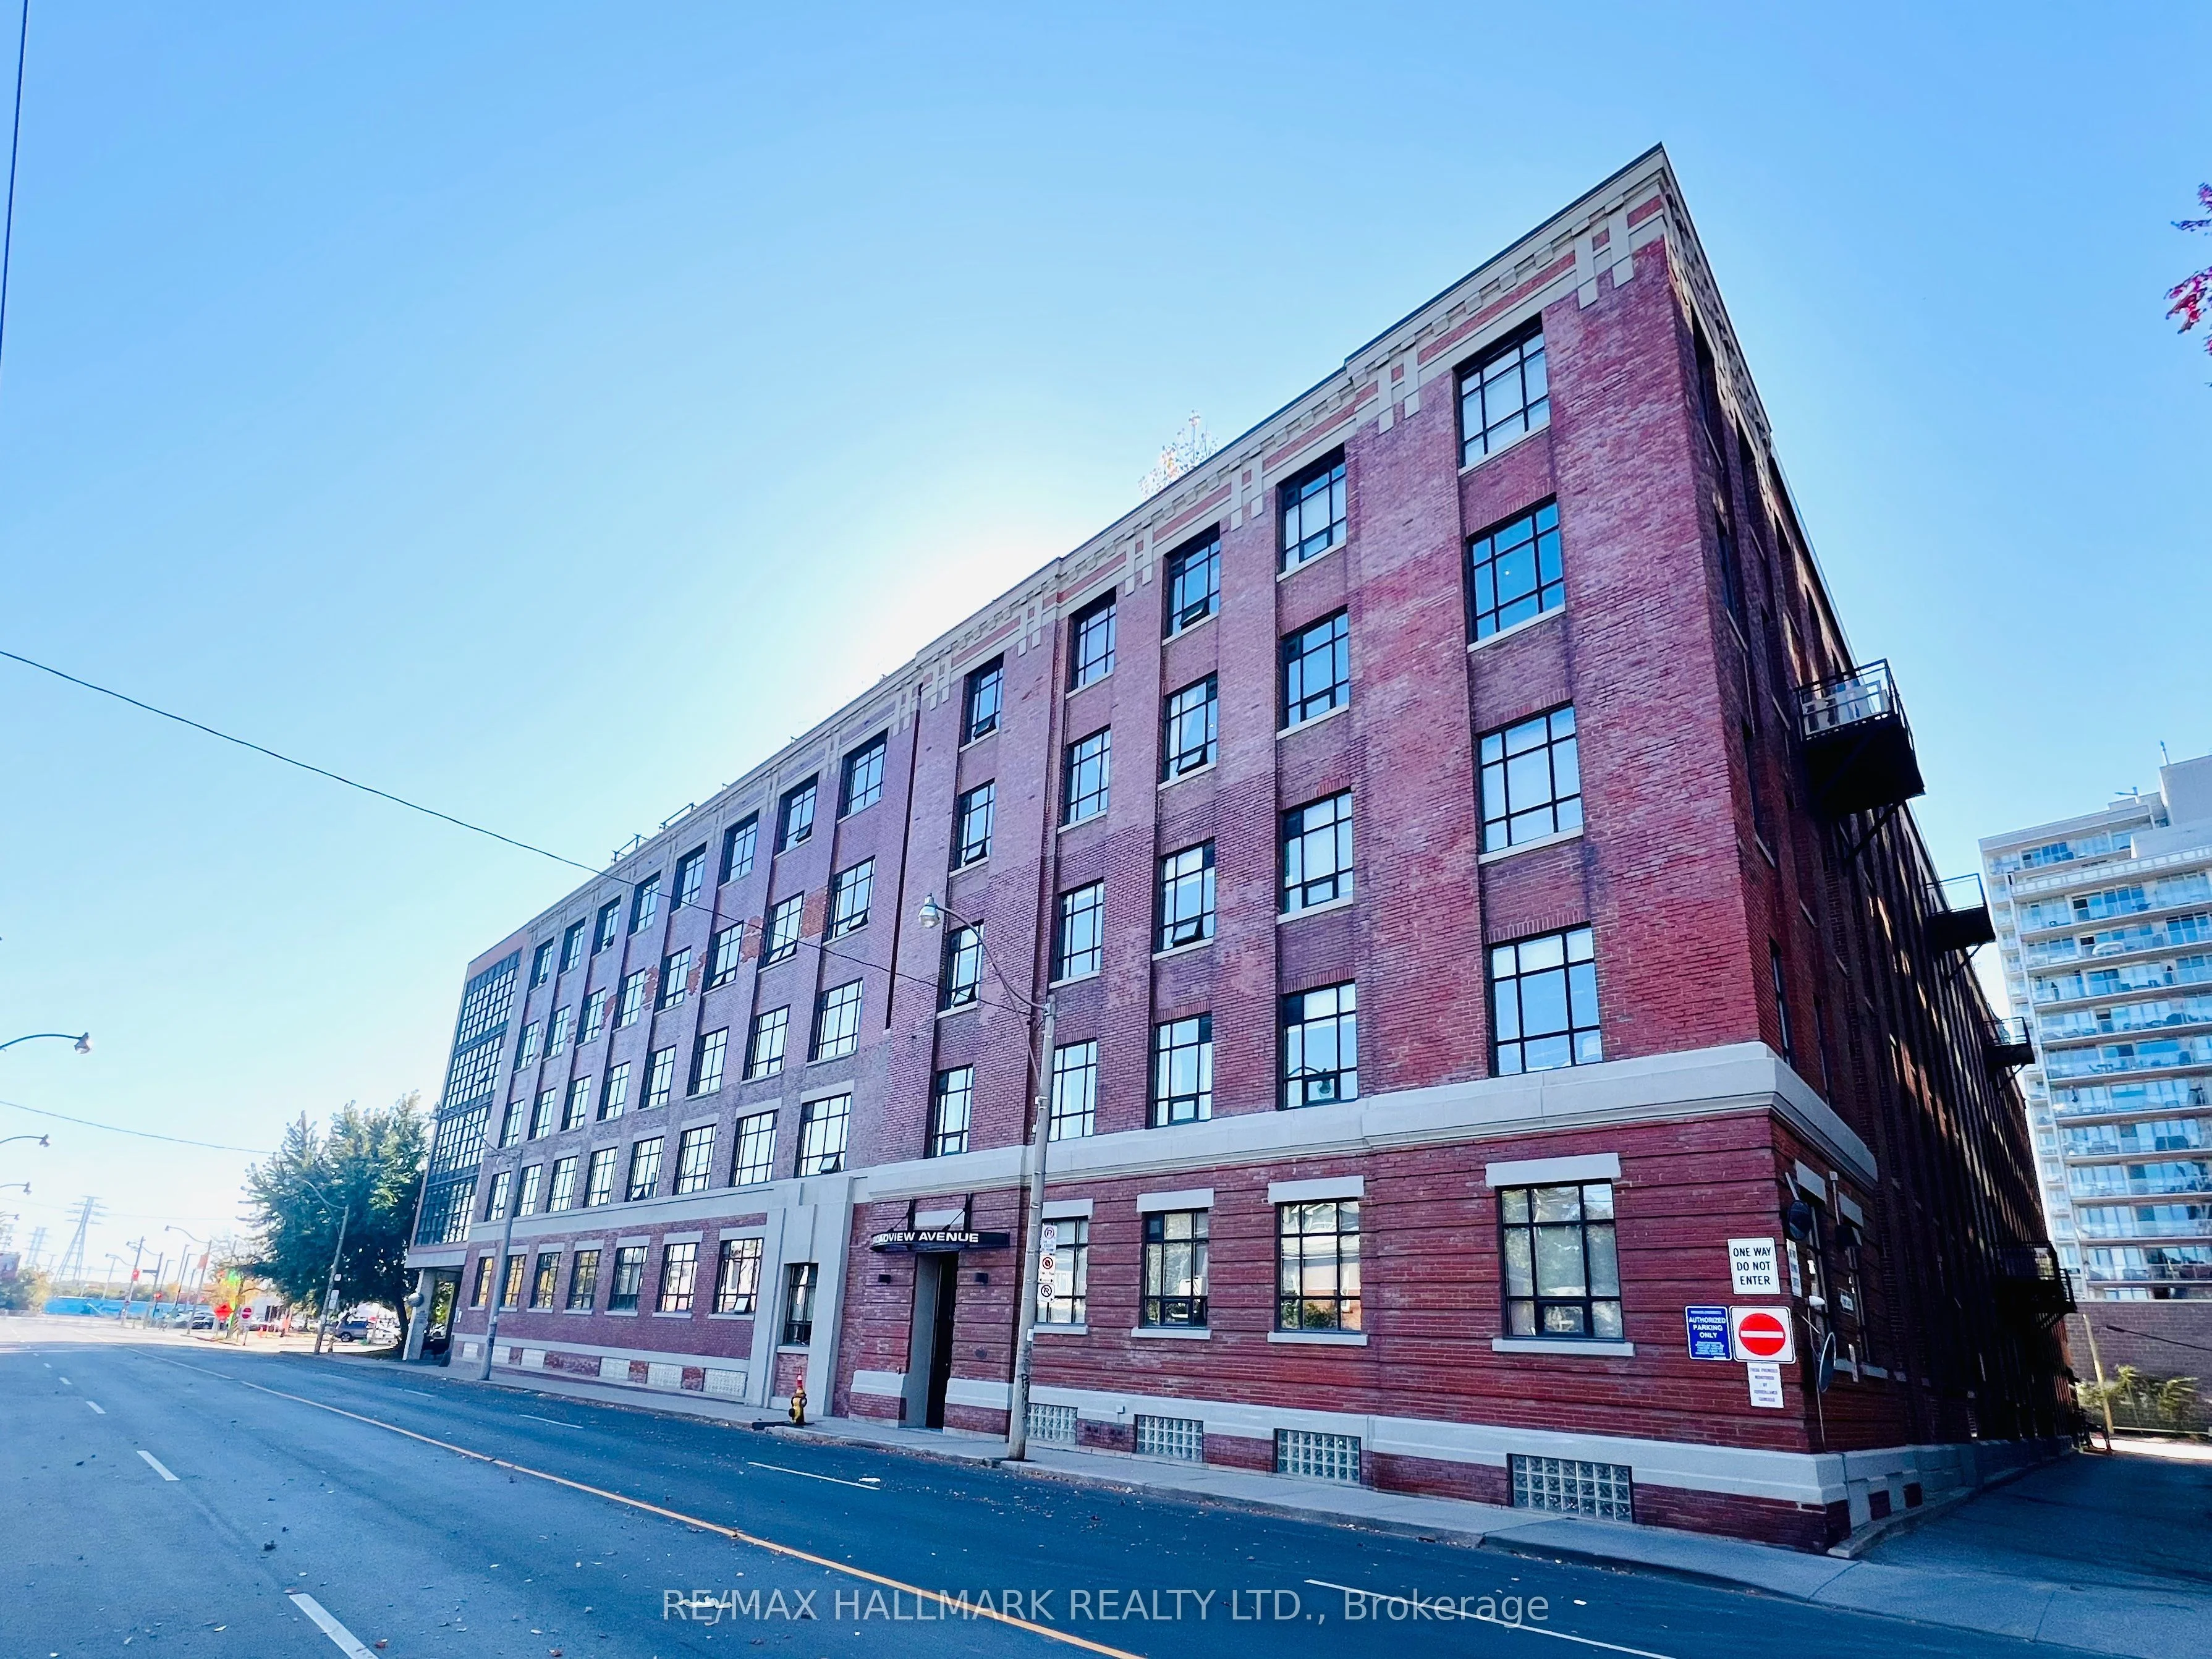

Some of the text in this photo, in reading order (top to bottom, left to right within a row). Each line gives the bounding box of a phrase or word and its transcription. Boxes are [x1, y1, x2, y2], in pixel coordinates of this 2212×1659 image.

[918, 1232, 979, 1243] AVENUE
[1733, 1247, 1771, 1257] ONE WAY
[1737, 1261, 1771, 1271] DO NOT
[1740, 1275, 1771, 1285] ENTER
